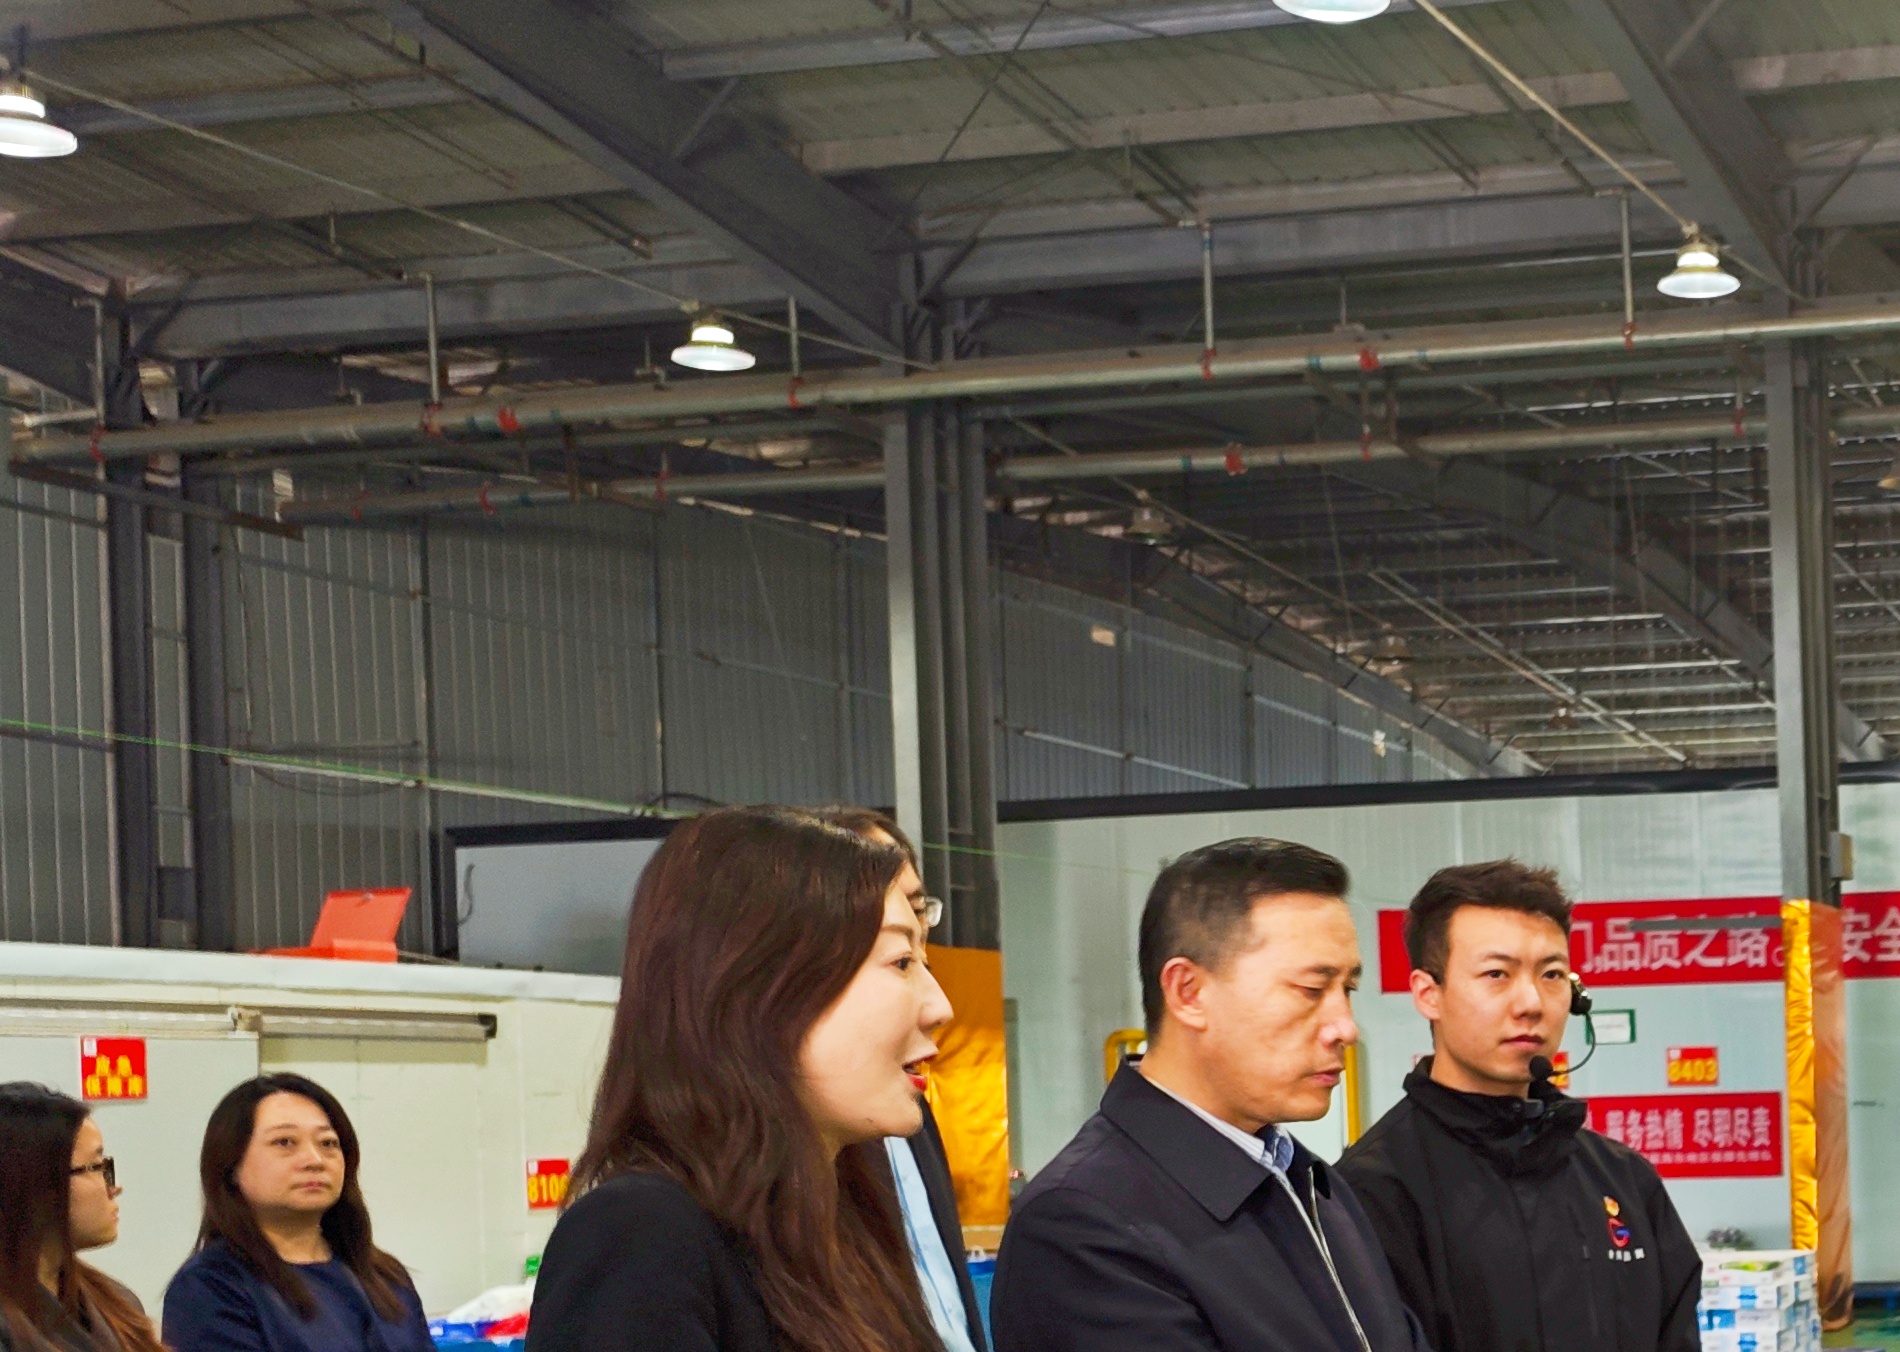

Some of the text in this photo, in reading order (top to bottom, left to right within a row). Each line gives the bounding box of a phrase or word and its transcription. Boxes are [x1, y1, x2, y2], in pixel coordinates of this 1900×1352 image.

[1668, 1058, 1718, 1083] 8403
[1693, 1106, 1771, 1148] 尽职尽责
